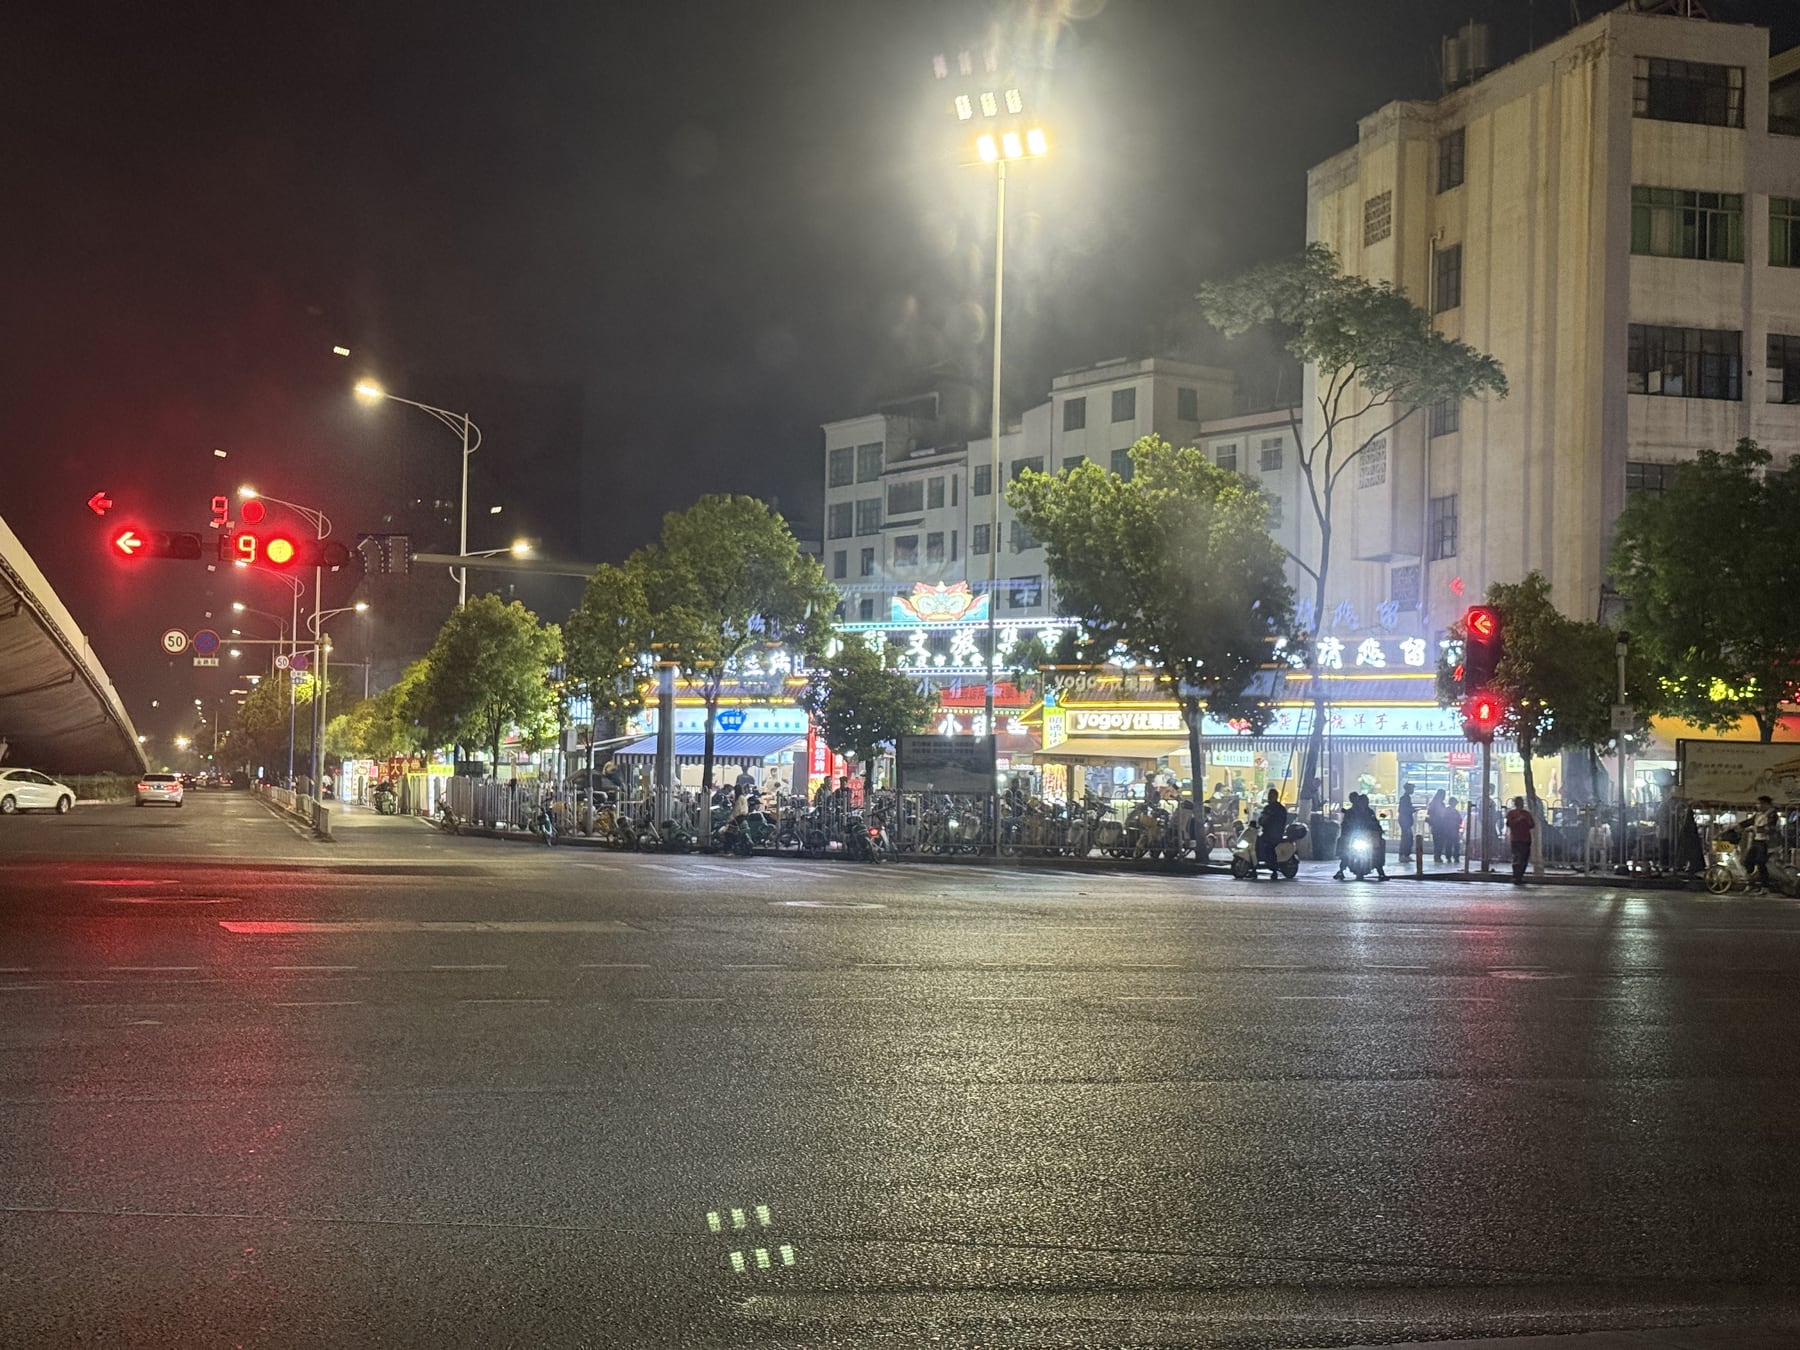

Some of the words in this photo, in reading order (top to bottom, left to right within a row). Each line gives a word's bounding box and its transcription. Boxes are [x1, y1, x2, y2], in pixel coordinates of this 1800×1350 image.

[237, 535, 256, 562] 9
[168, 635, 183, 648] 50
[277, 658, 288, 667] 50
